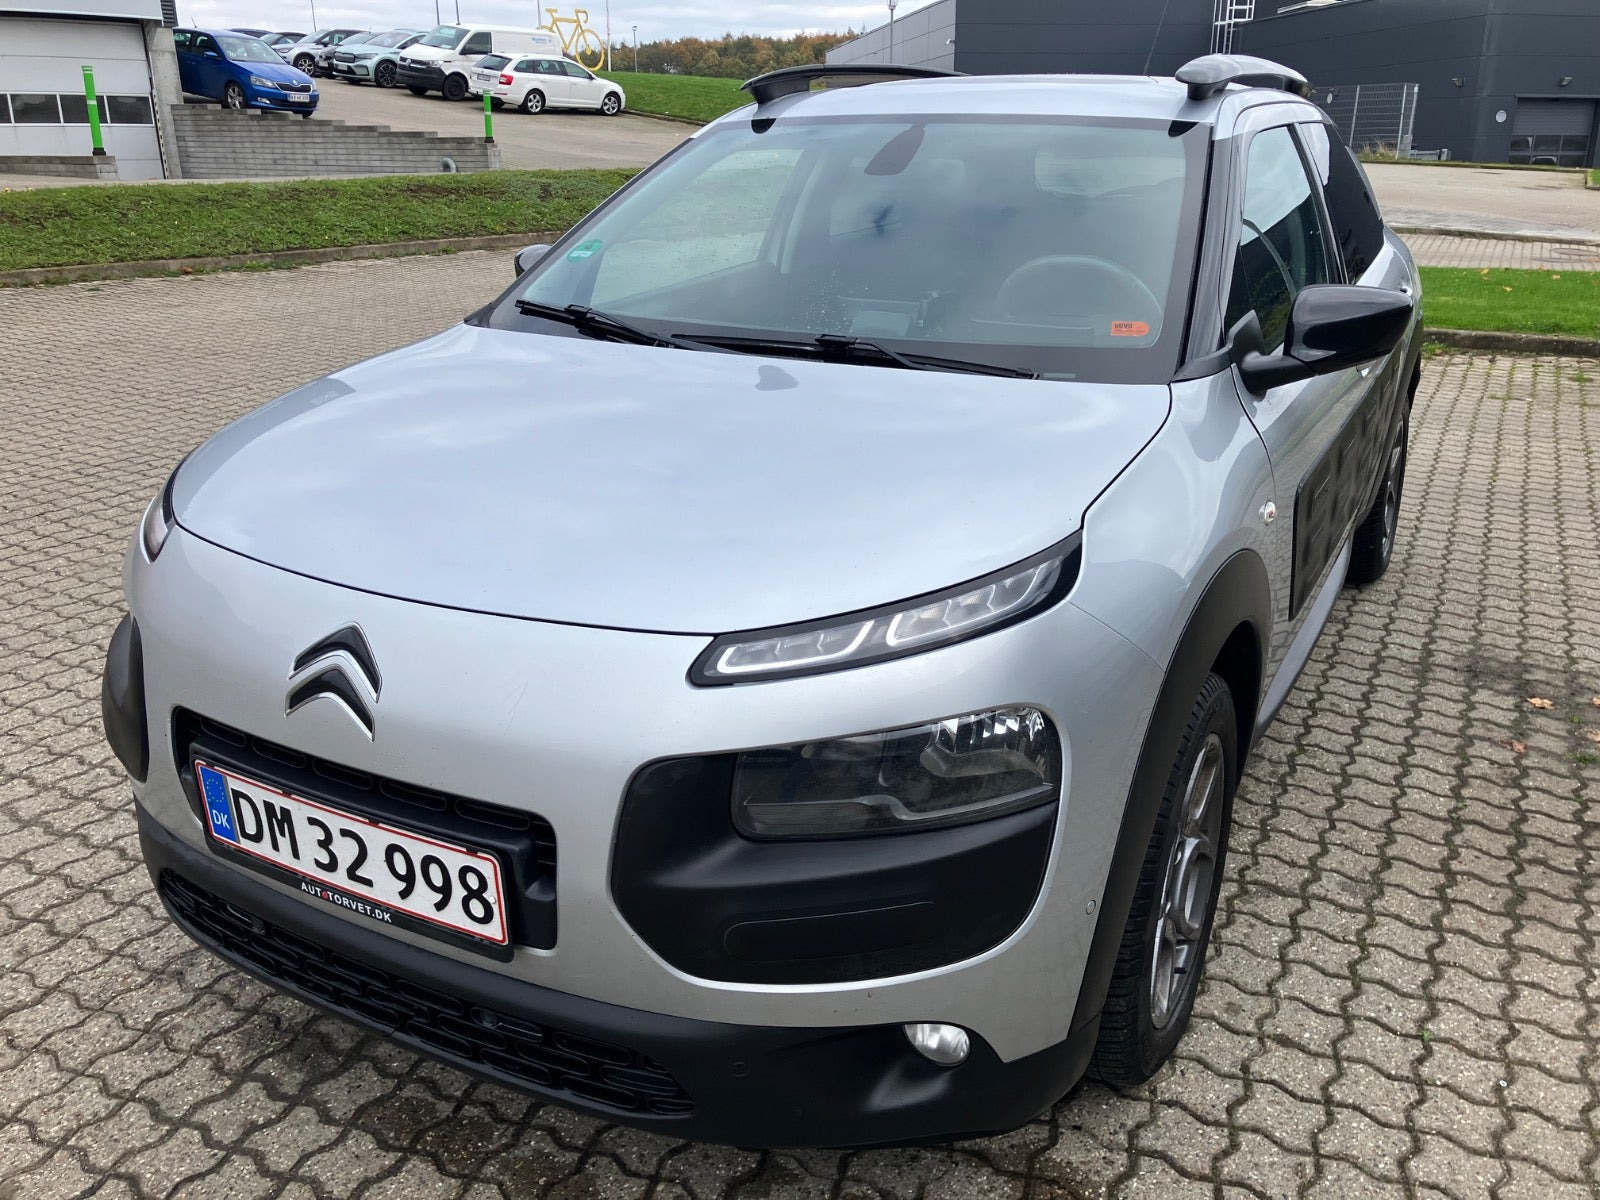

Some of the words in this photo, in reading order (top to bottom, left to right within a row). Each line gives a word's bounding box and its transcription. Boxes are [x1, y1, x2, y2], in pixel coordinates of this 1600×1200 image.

[212, 809, 230, 830] DK
[230, 787, 300, 860] DM
[306, 816, 374, 888] 32
[384, 842, 494, 925] 998
[301, 881, 392, 923] AUTOTORVET.DK
